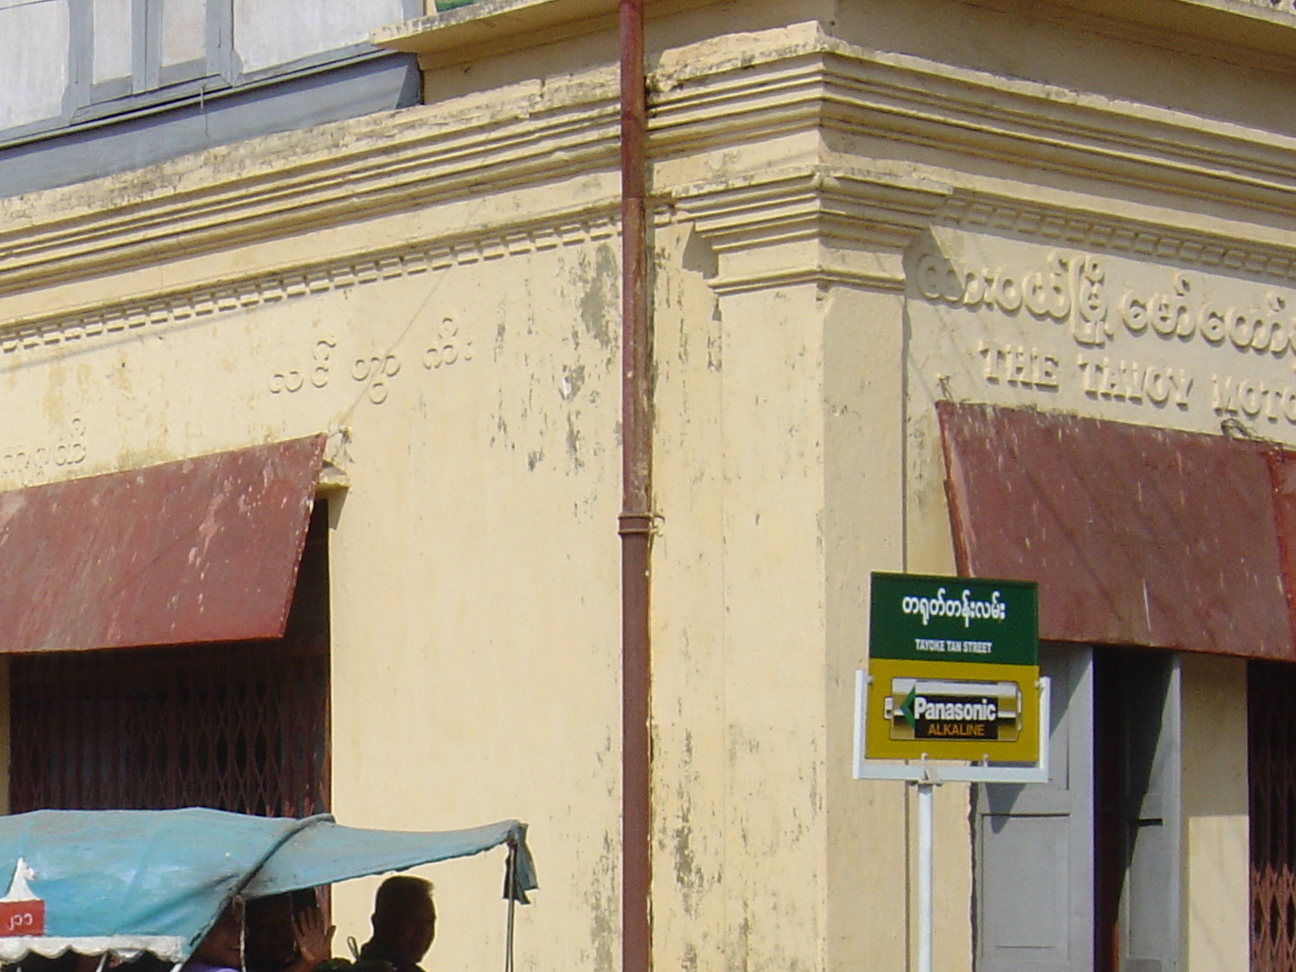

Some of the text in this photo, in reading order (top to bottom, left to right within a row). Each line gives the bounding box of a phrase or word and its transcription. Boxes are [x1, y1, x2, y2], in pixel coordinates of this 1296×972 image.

[978, 338, 1060, 393] THE
[1077, 353, 1194, 411] TAVOY
[902, 587, 1006, 627] တရုတ်တန်းလမ်း
[915, 638, 992, 654] TAYOKE TAN STREET
[914, 697, 997, 721] Panasonic
[927, 723, 985, 737] ALKALINE
